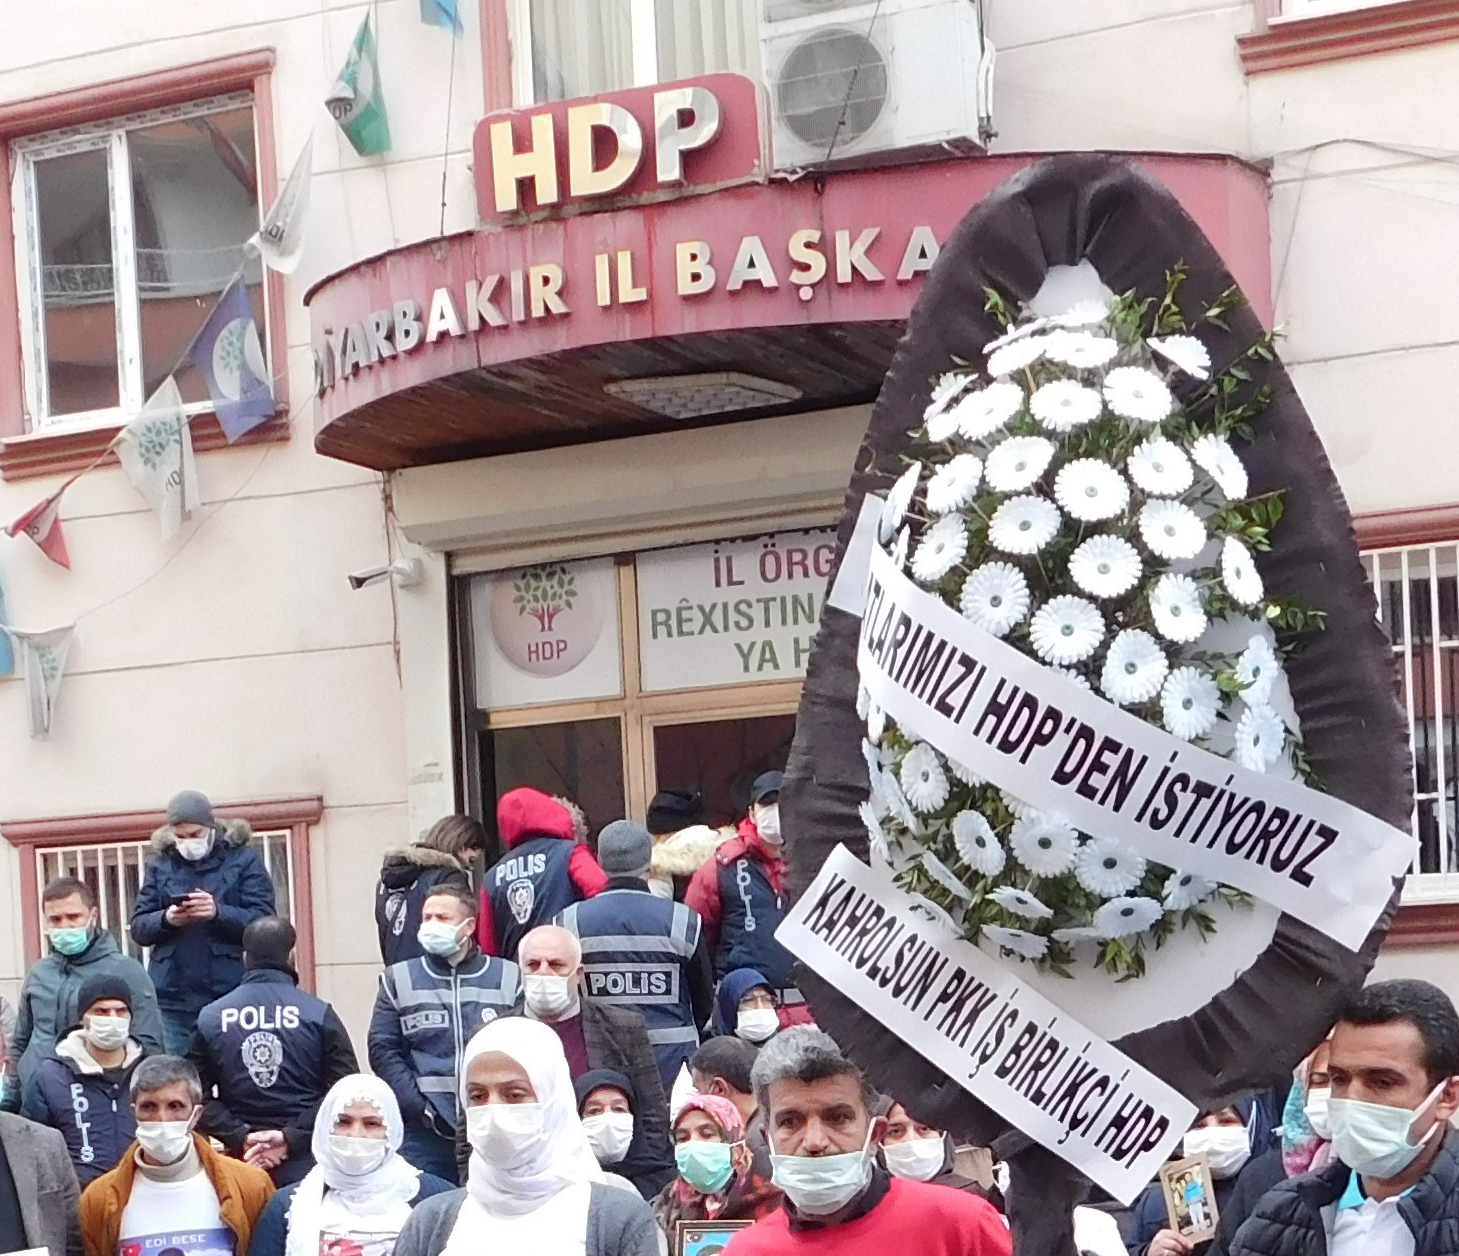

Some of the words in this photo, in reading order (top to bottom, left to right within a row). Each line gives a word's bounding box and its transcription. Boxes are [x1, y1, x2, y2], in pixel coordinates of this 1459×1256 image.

[488, 86, 722, 213] HDP
[713, 549, 745, 588] İL
[527, 639, 569, 663] HDP
[734, 639, 780, 673] YA
[862, 571, 987, 725] TLARIMIZI
[972, 678, 1150, 812] HDP'DEN
[1134, 750, 1339, 889] İSTİYORUZ
[802, 872, 950, 1012] KAHROLSUN
[923, 966, 999, 1048] PKK
[968, 988, 1019, 1079] İŞ
[994, 1017, 1130, 1145] BİRLİKÇİ
[1094, 1092, 1170, 1169] HDP
